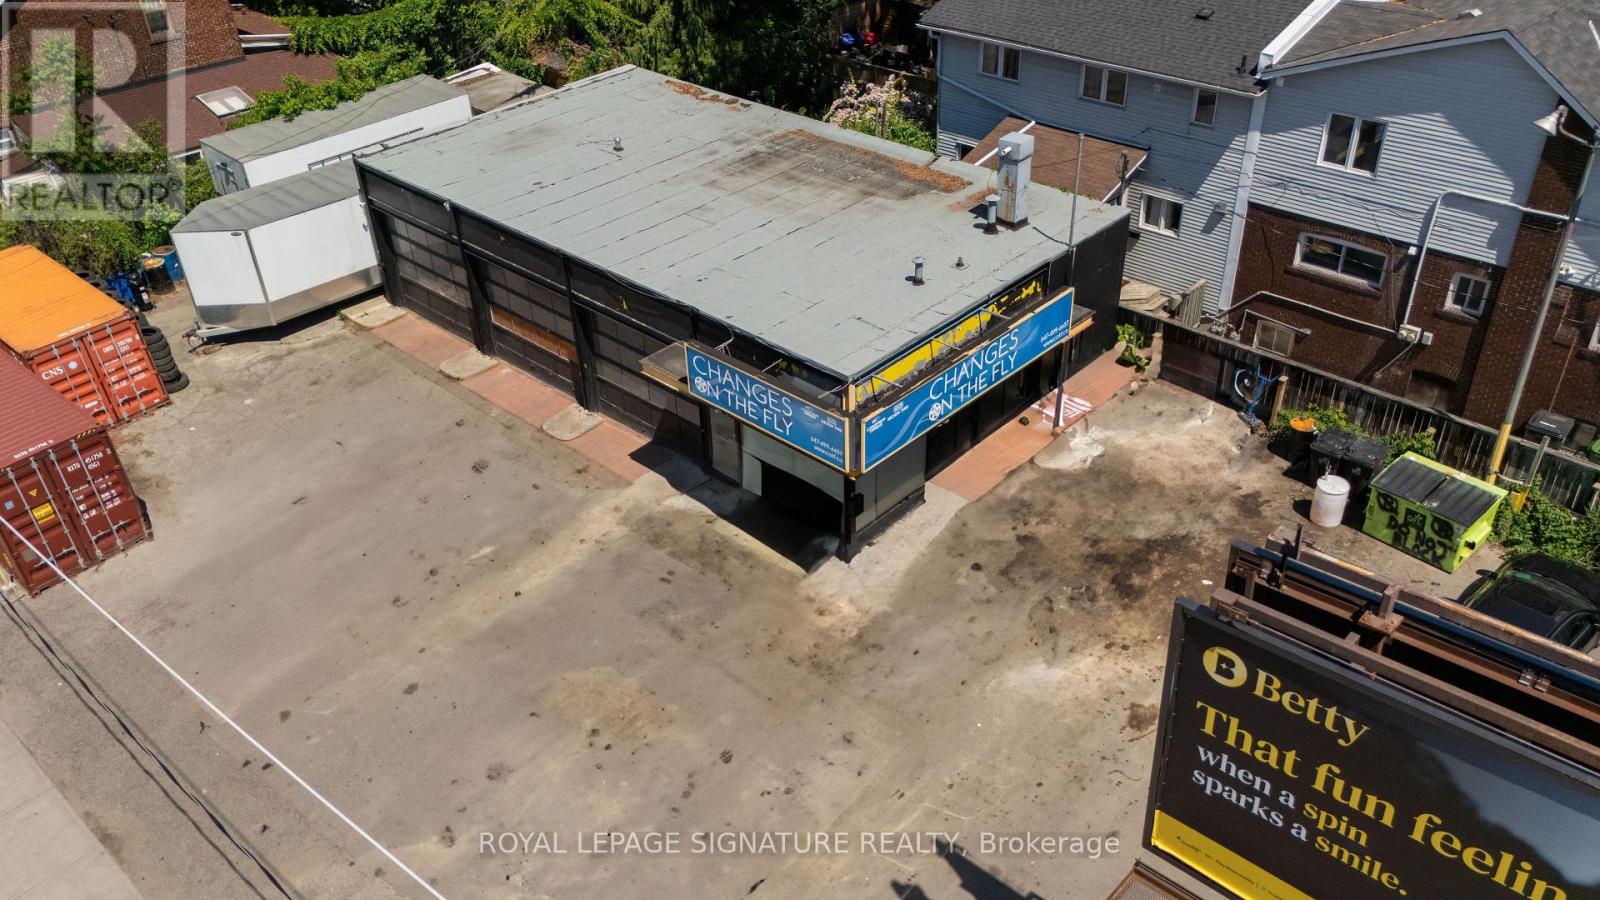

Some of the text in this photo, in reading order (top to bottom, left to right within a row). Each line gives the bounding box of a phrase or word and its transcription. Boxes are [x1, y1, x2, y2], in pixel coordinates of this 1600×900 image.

[41, 366, 64, 381] CNS
[693, 355, 792, 417] CHANGES
[929, 328, 1019, 400] CHANGES
[958, 371, 989, 402] THE
[991, 350, 1019, 382] FLY
[722, 388, 758, 420] THE
[763, 408, 793, 436] FLY
[1253, 668, 1370, 747] Betty
[1196, 701, 1303, 779] That
[1310, 763, 1396, 829] fun
[1197, 745, 1368, 848] when a spin
[1192, 768, 1284, 828] sparks
[1290, 822, 1309, 842] a
[1314, 835, 1408, 896] smile.
